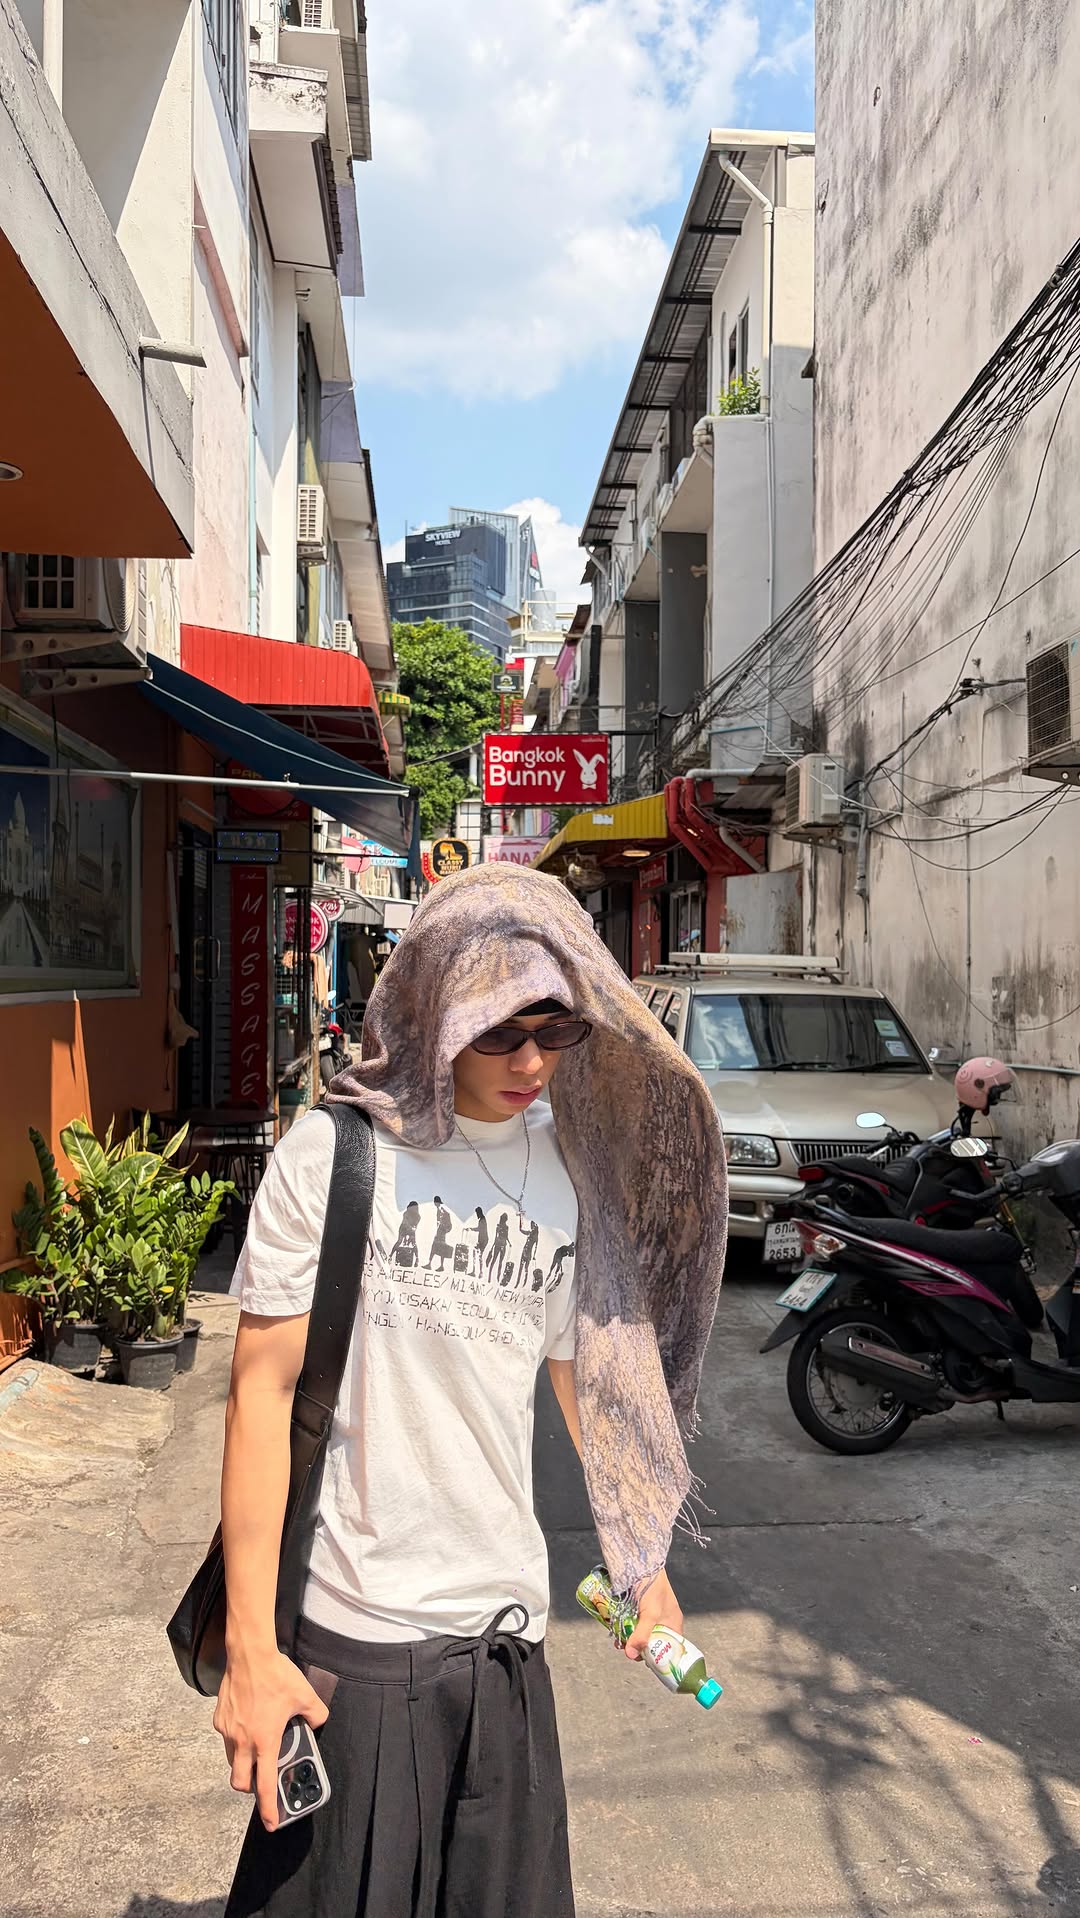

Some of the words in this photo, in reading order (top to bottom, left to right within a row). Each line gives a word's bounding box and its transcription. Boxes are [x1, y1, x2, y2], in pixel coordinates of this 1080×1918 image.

[425, 530, 462, 542] SKYVIEW
[489, 746, 566, 768] Bangkok
[489, 764, 566, 792] Bunny
[240, 893, 264, 1096] MASSAGE
[769, 1247, 797, 1260] 2653
